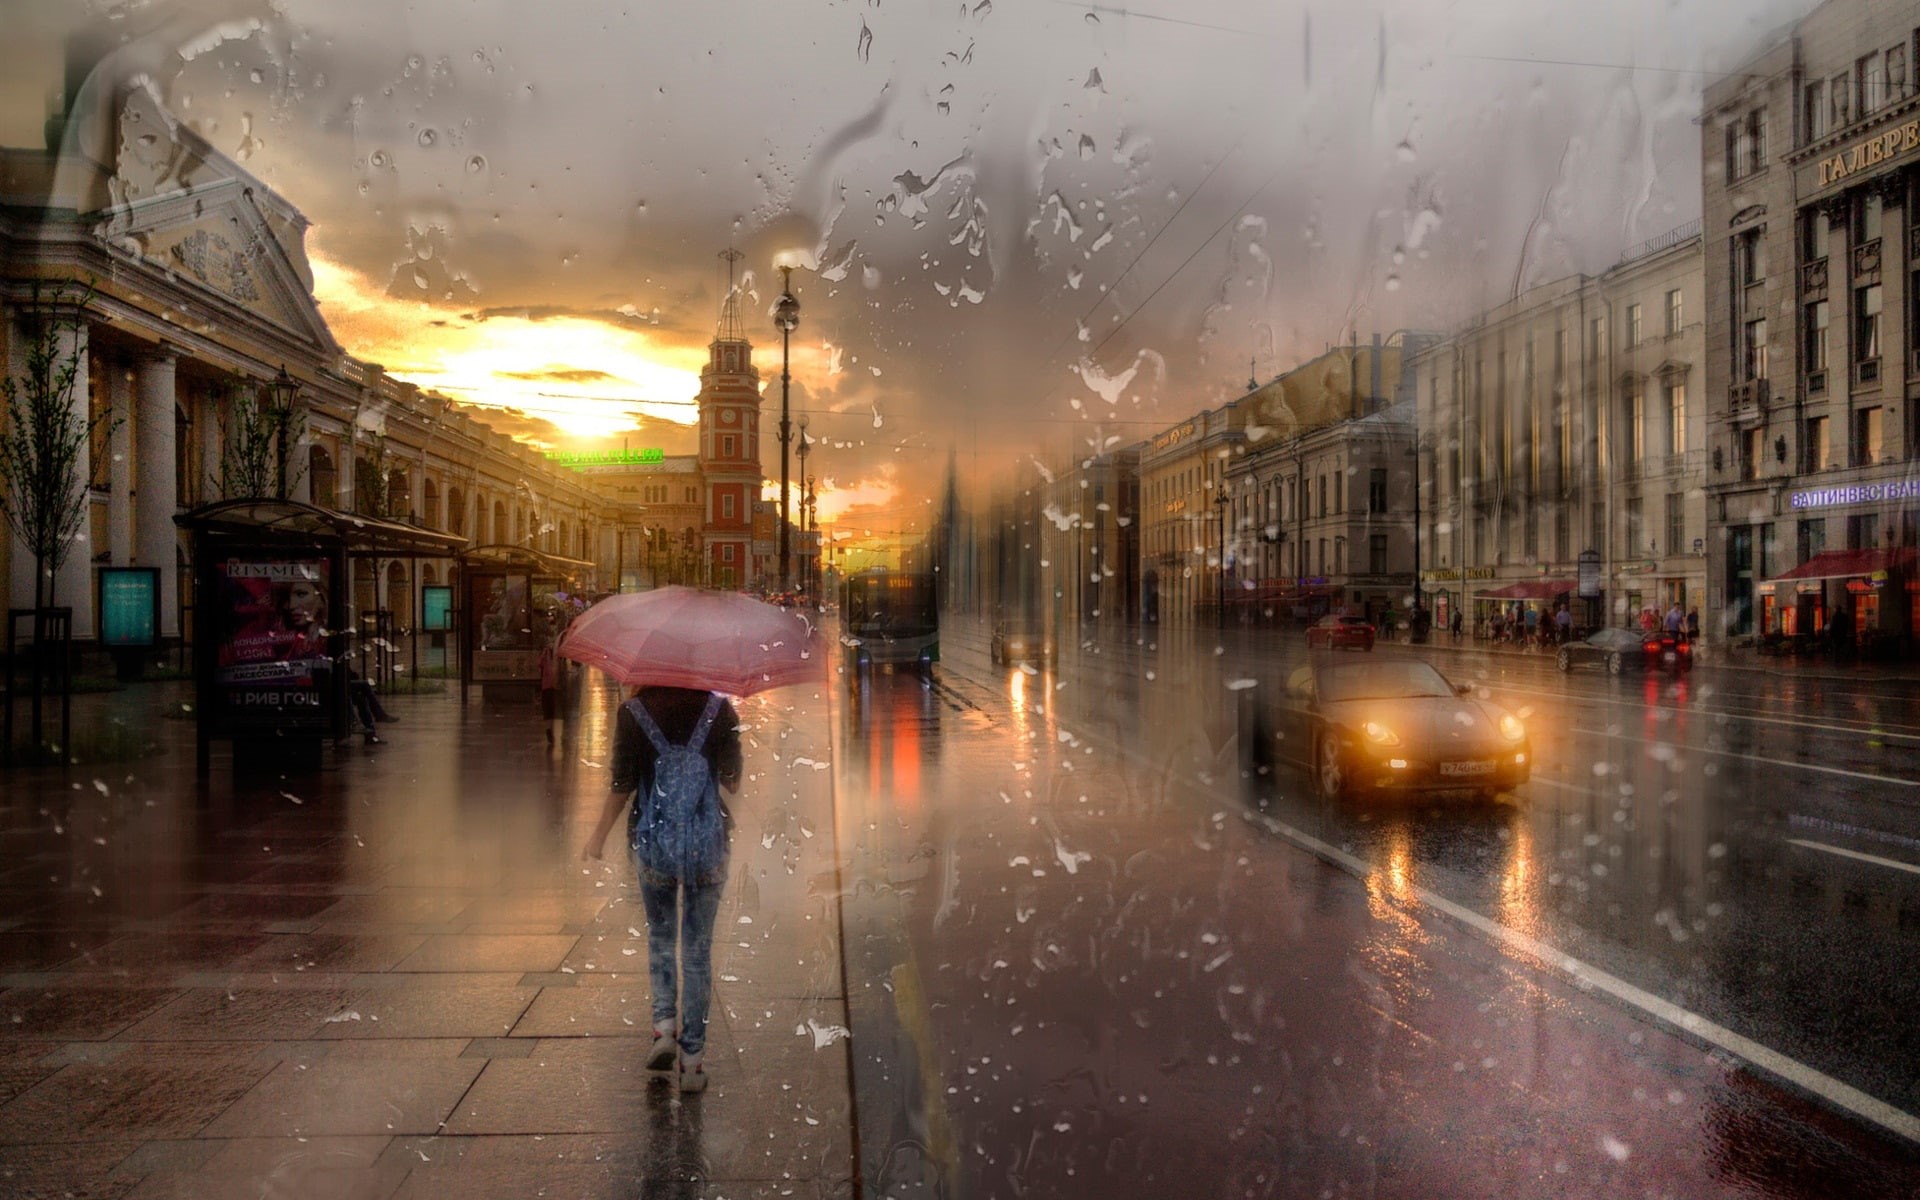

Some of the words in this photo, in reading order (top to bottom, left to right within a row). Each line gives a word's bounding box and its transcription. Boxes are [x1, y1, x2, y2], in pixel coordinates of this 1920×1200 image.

[1819, 120, 1920, 186] ГАЛЕРЕ
[245, 692, 281, 705] РИВ
[284, 692, 320, 705] ГОШ
